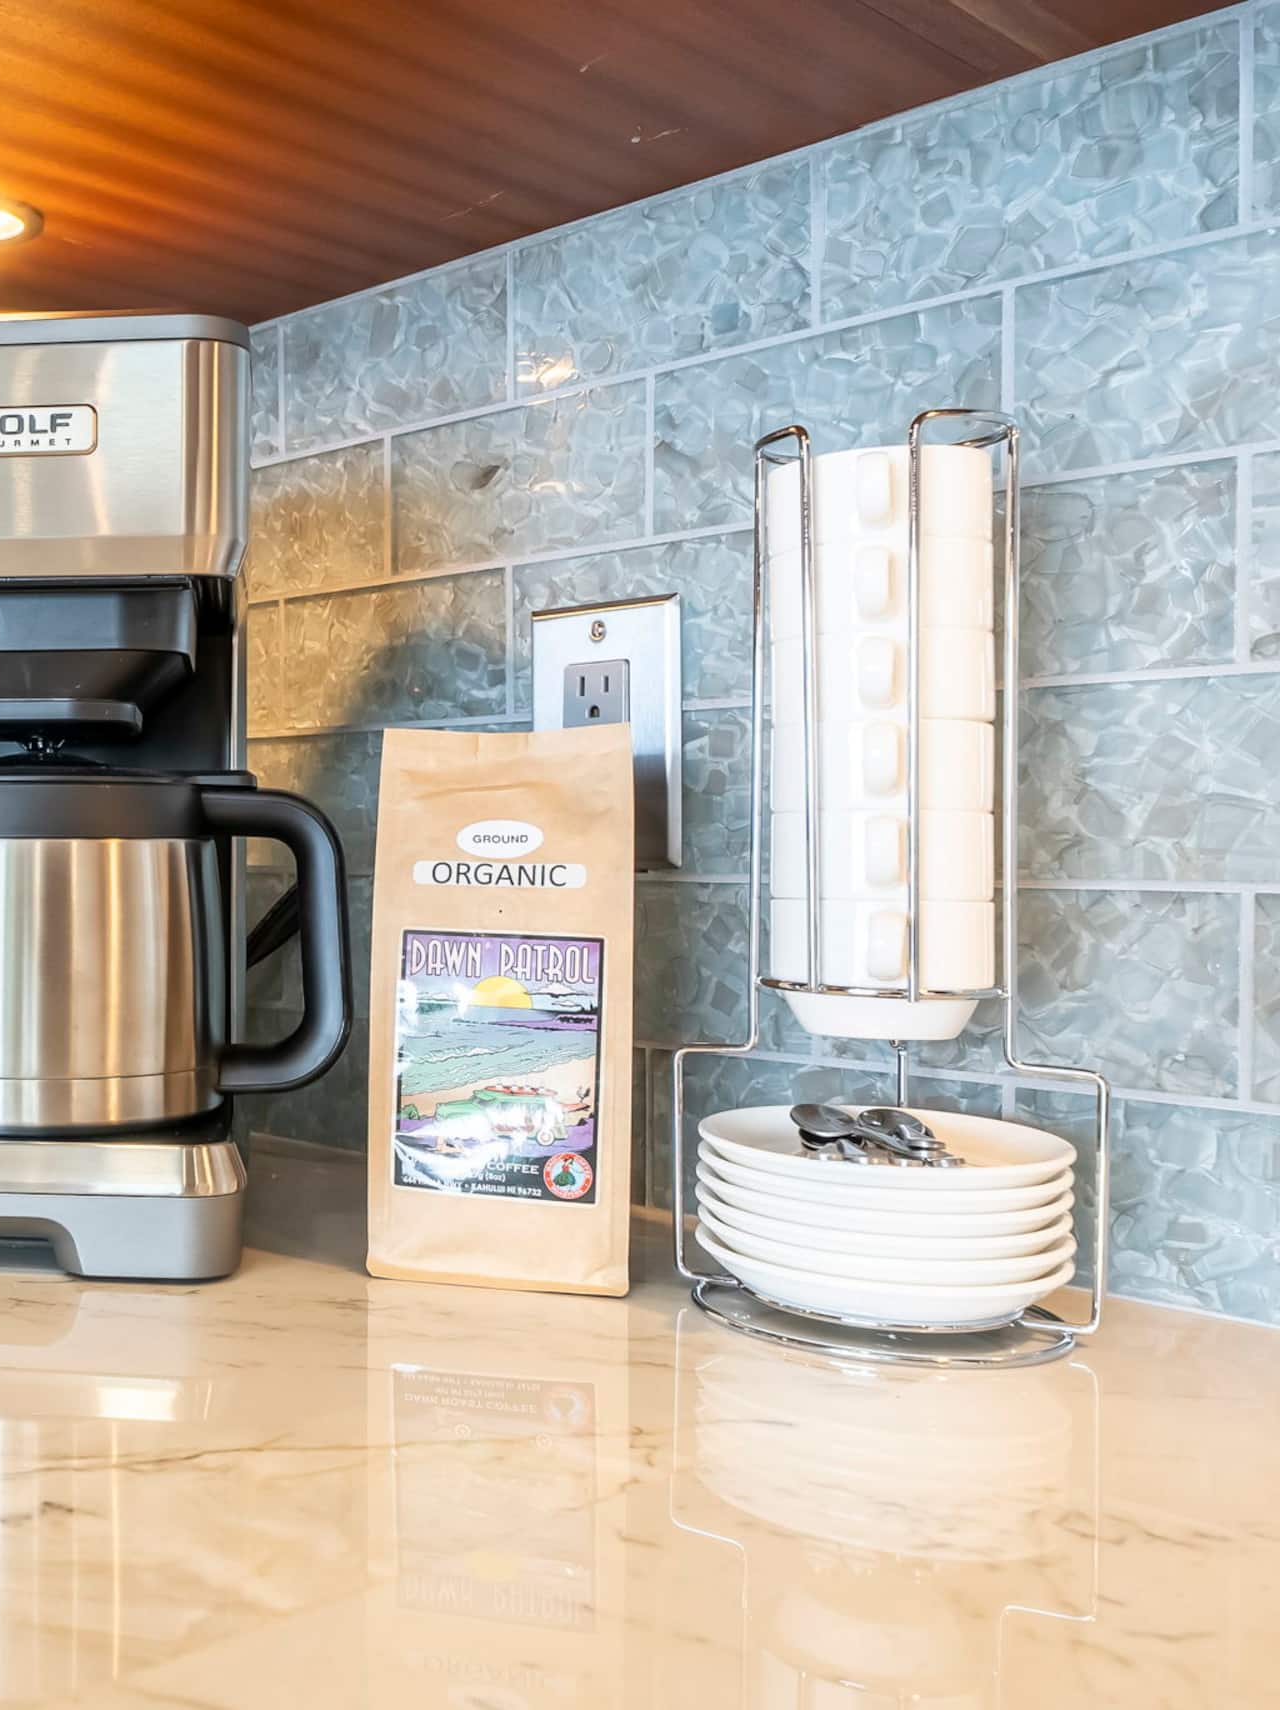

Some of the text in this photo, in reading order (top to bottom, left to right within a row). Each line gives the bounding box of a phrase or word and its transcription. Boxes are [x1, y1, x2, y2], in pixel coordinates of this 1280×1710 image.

[472, 834, 528, 845] GROUND
[432, 862, 567, 887] ORGANIC
[410, 939, 595, 984] DAWN PATROL
[486, 1161, 539, 1175] COFFEE
